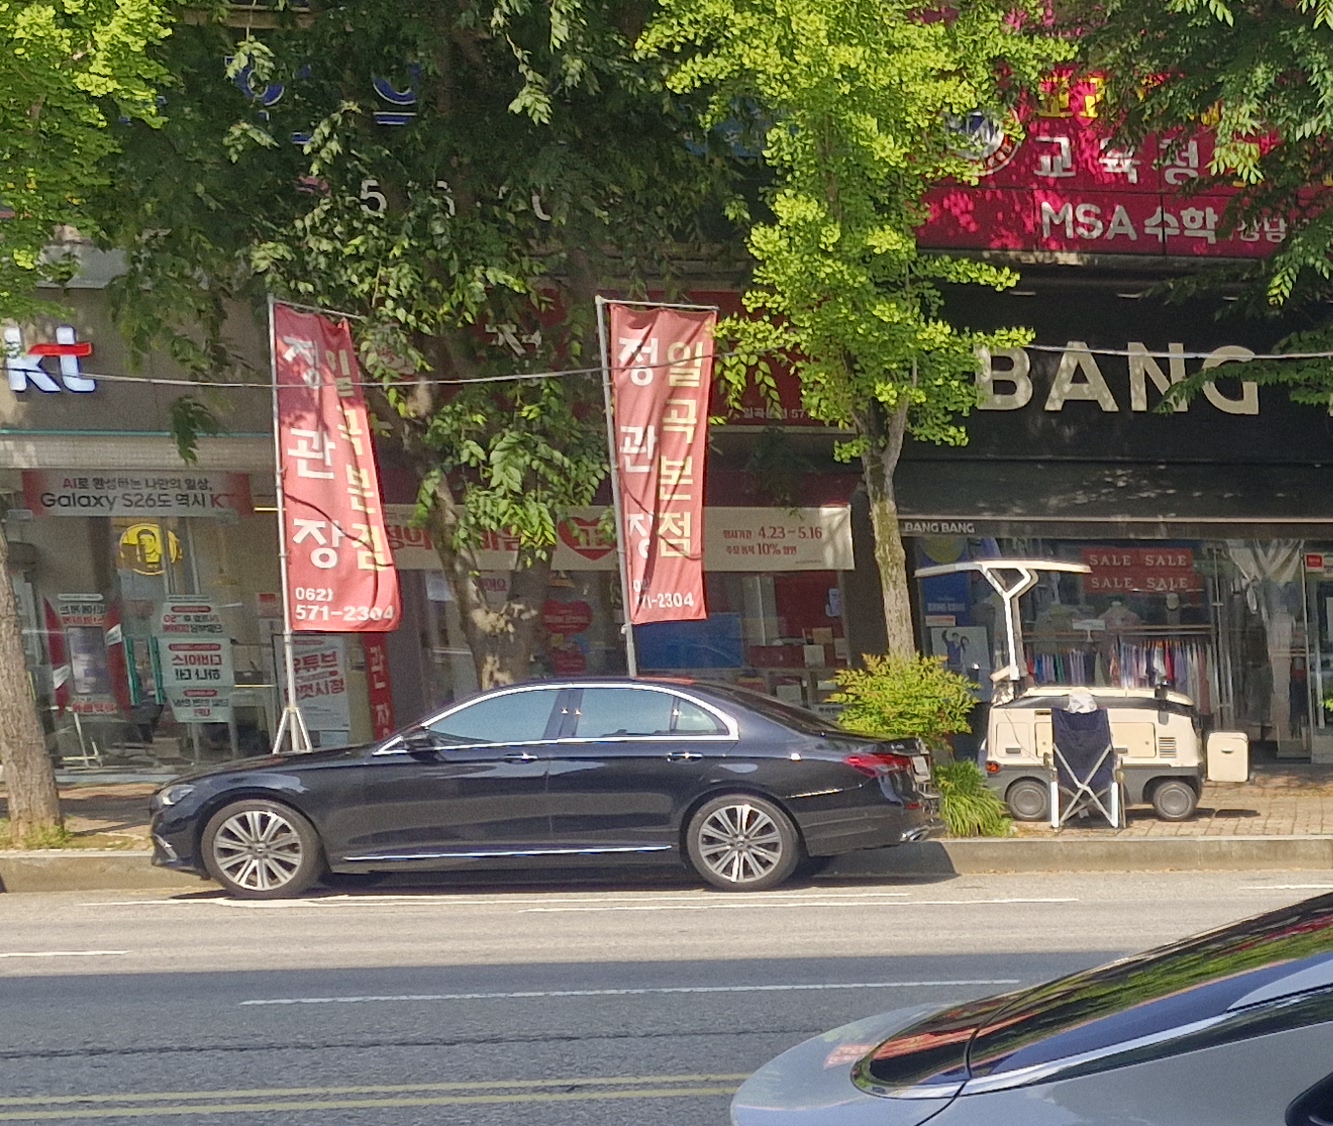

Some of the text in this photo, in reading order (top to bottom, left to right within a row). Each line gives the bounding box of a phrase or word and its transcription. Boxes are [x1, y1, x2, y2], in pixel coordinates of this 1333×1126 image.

[1040, 202, 1137, 240] MSA
[1144, 207, 1217, 243] 수학
[973, 342, 1260, 415] BANG
[283, 335, 342, 569] 정관장
[657, 341, 703, 558] 일곡본점
[40, 492, 117, 511] Galaxy
[758, 526, 786, 539] 4.23
[798, 526, 823, 539] 5.16
[904, 522, 975, 533] BANG BANG
[757, 543, 781, 555] 10%
[1090, 555, 1187, 567] SALE SALE
[1091, 578, 1189, 588] SALE SALE
[295, 604, 395, 621] 571-2304
